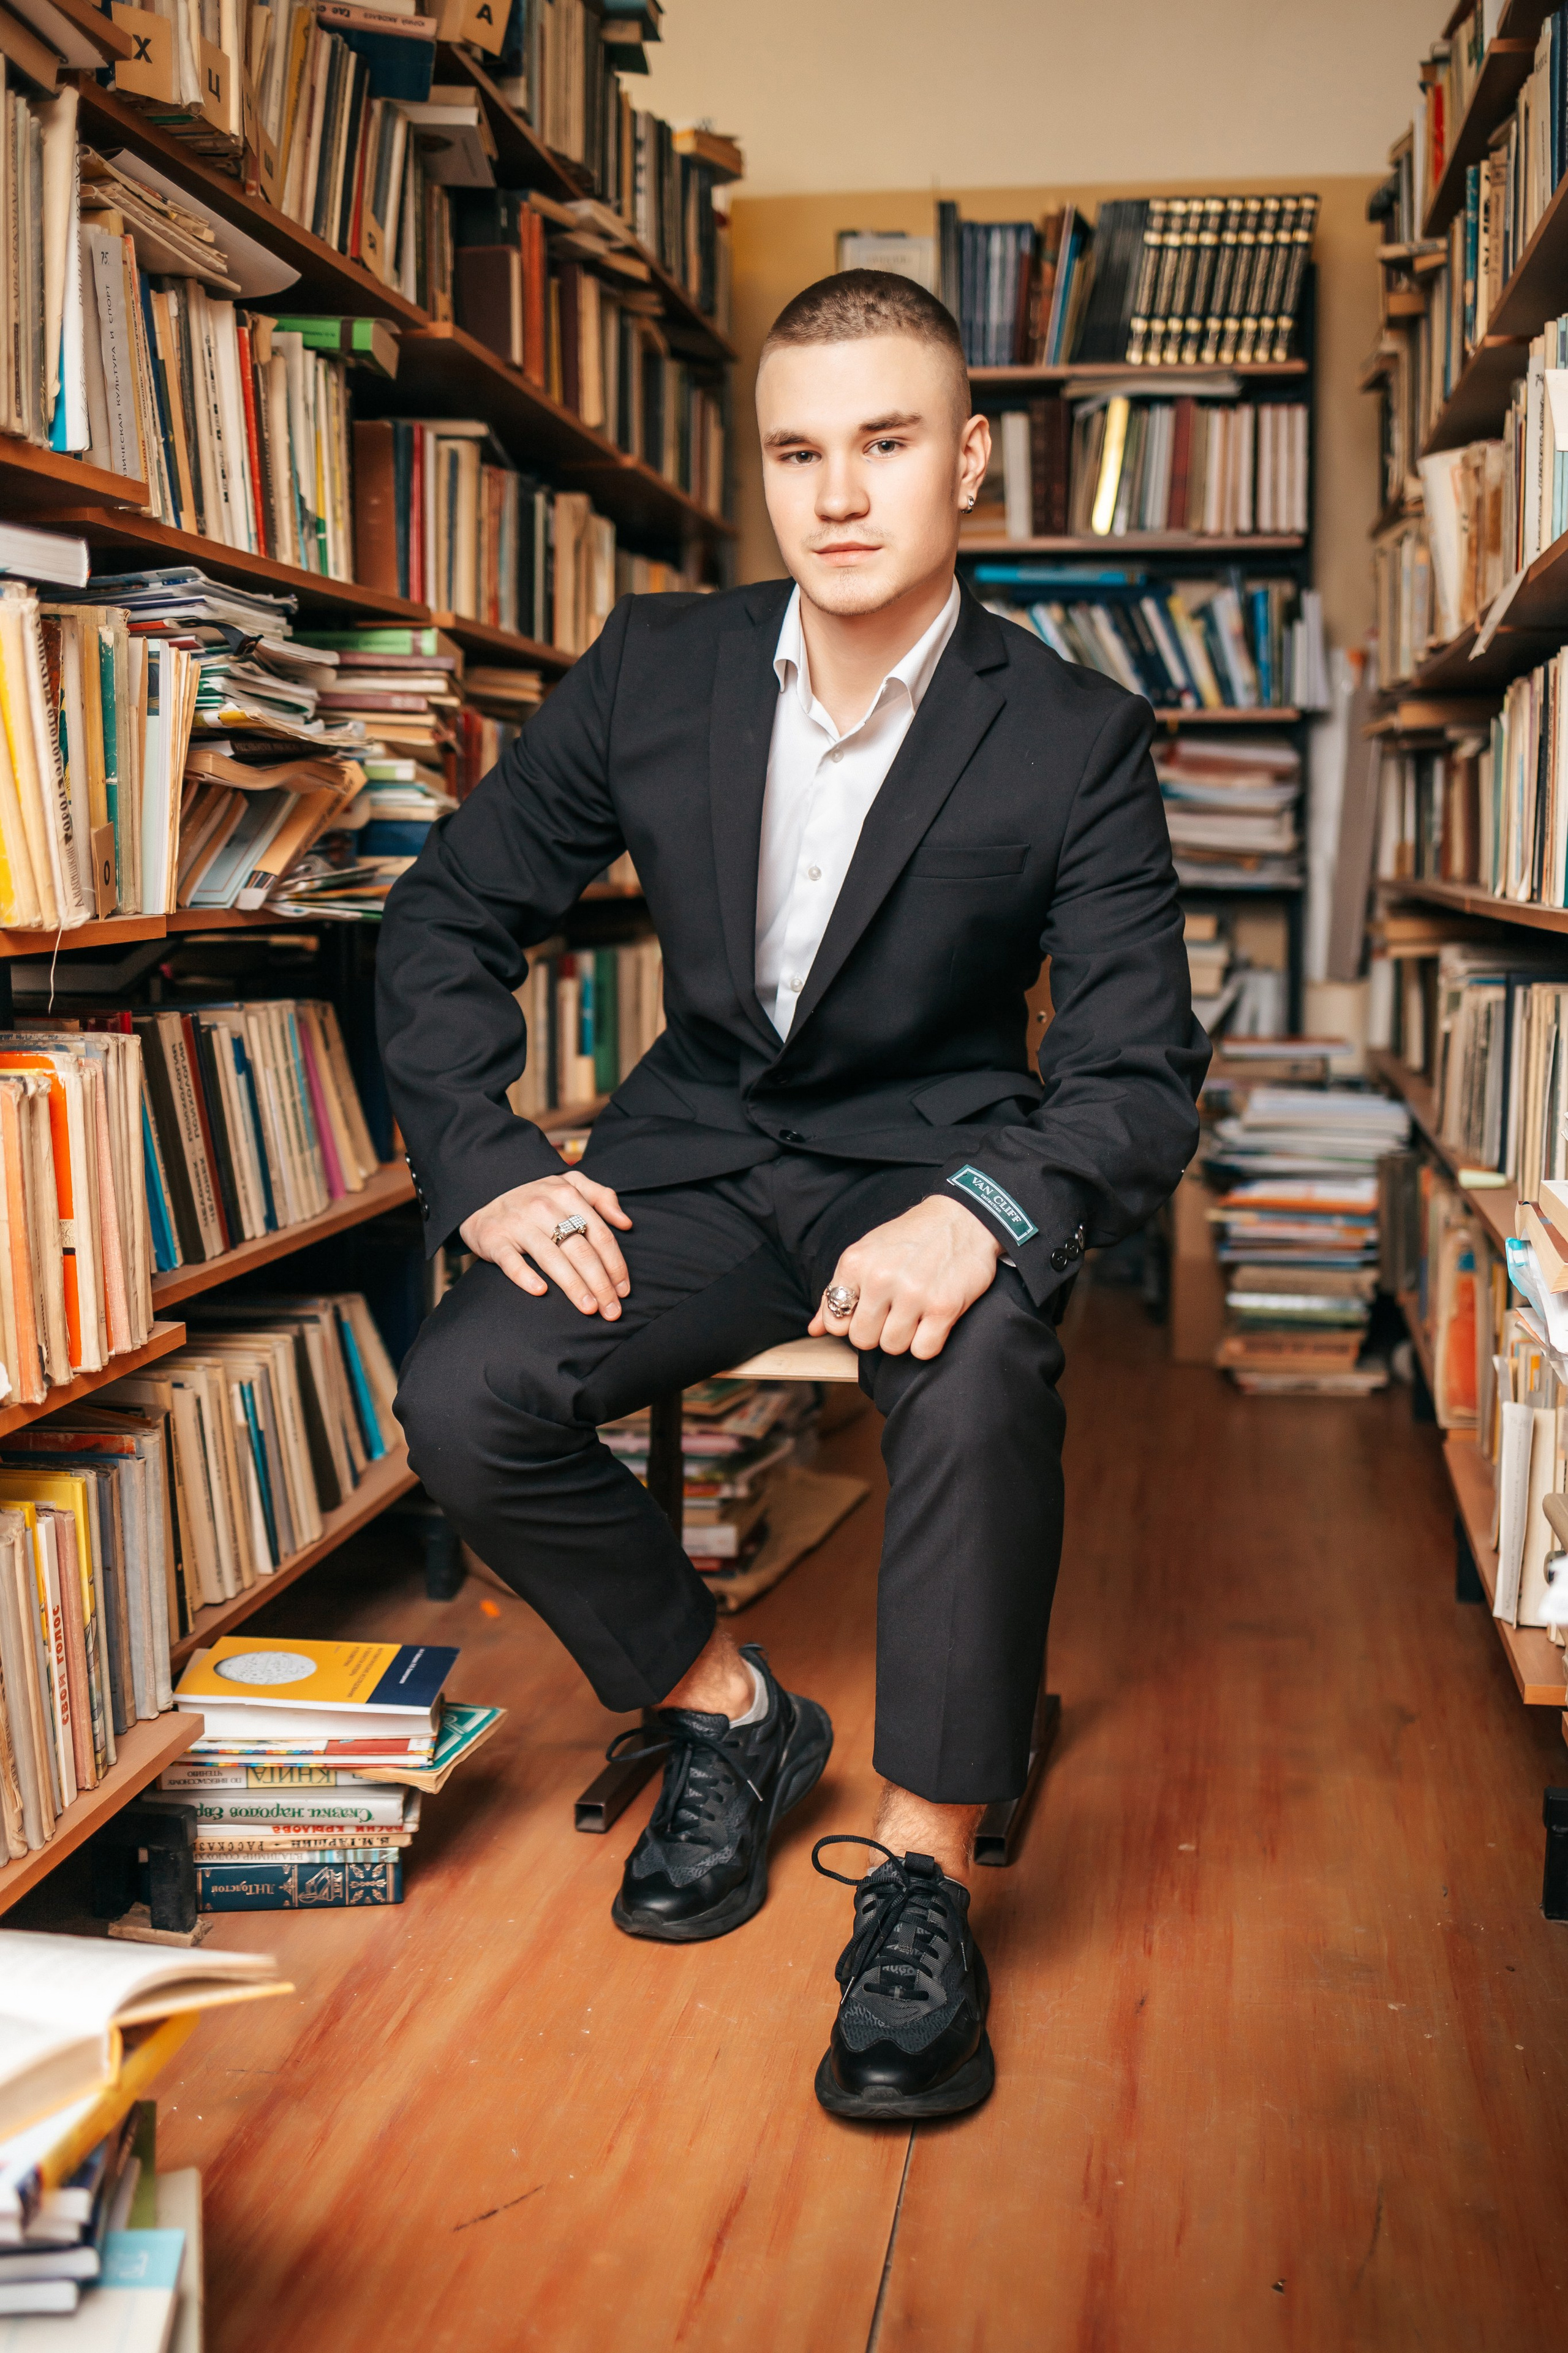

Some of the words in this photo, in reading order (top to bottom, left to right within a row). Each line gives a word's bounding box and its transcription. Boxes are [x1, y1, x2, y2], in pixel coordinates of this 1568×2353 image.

[475, 3, 493, 26] А
[132, 34, 153, 64] Х
[208, 67, 221, 103] Ц
[105, 284, 114, 324] СПОРТ
[110, 331, 115, 339] И
[111, 346, 121, 406] КУЛЬТУРА
[971, 1177, 993, 1195] VAN
[993, 1195, 1022, 1222] CLIFF
[980, 1193, 1002, 1213] collection
[52, 1604, 65, 1666] ГОЛОС
[58, 1672, 70, 1726] СВОЙ
[249, 1766, 333, 1784] КНИГА
[229, 1802, 305, 1818] народов
[307, 1807, 375, 1823] Сказки
[243, 1853, 303, 1861] ВЛАДИМИР
